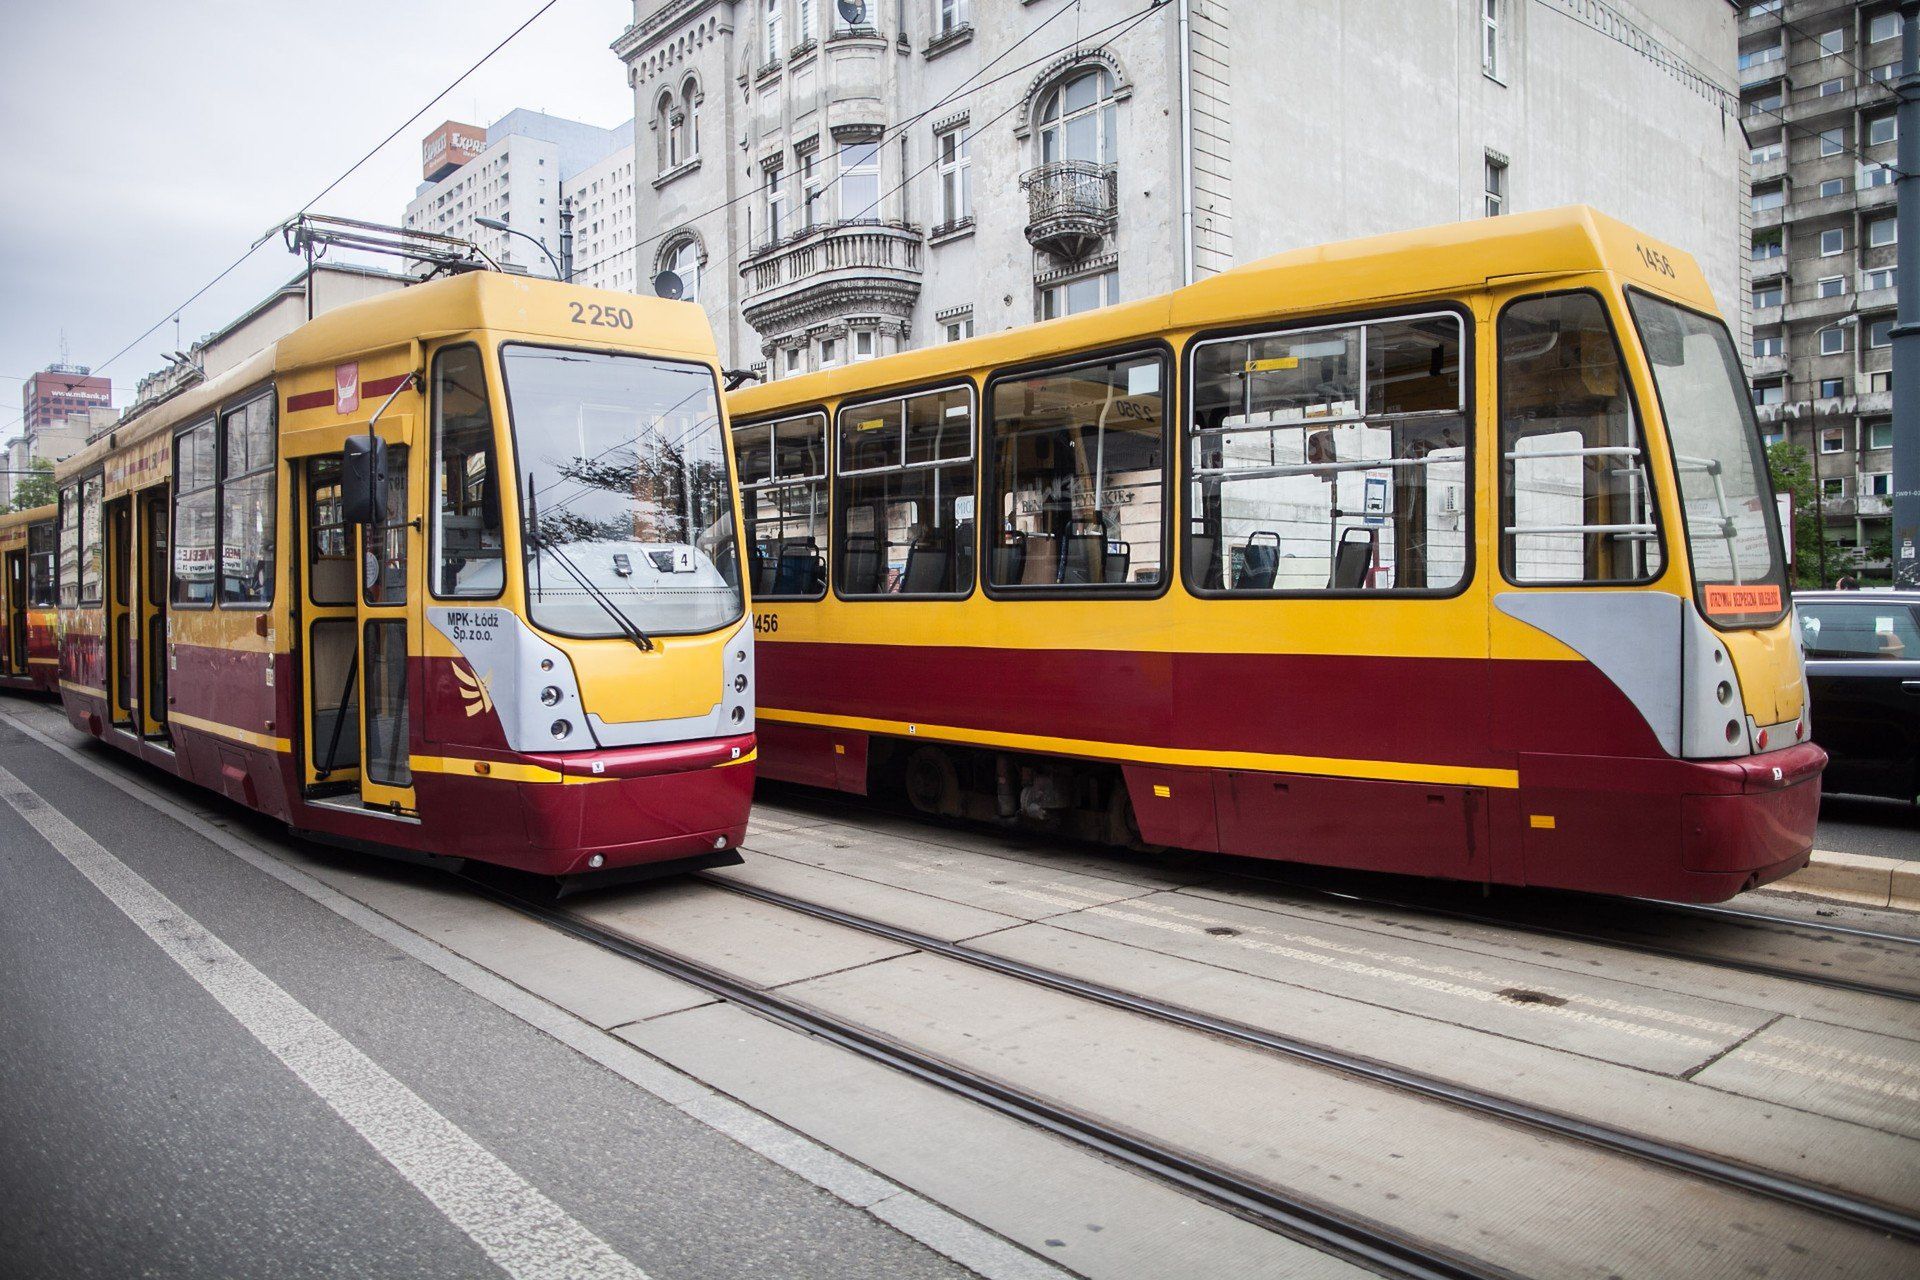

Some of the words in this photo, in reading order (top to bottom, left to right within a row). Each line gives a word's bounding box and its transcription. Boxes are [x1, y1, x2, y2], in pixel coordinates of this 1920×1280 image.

[1636, 243, 1676, 279] 1456
[568, 301, 634, 330] 2250
[680, 553, 688, 566] 4
